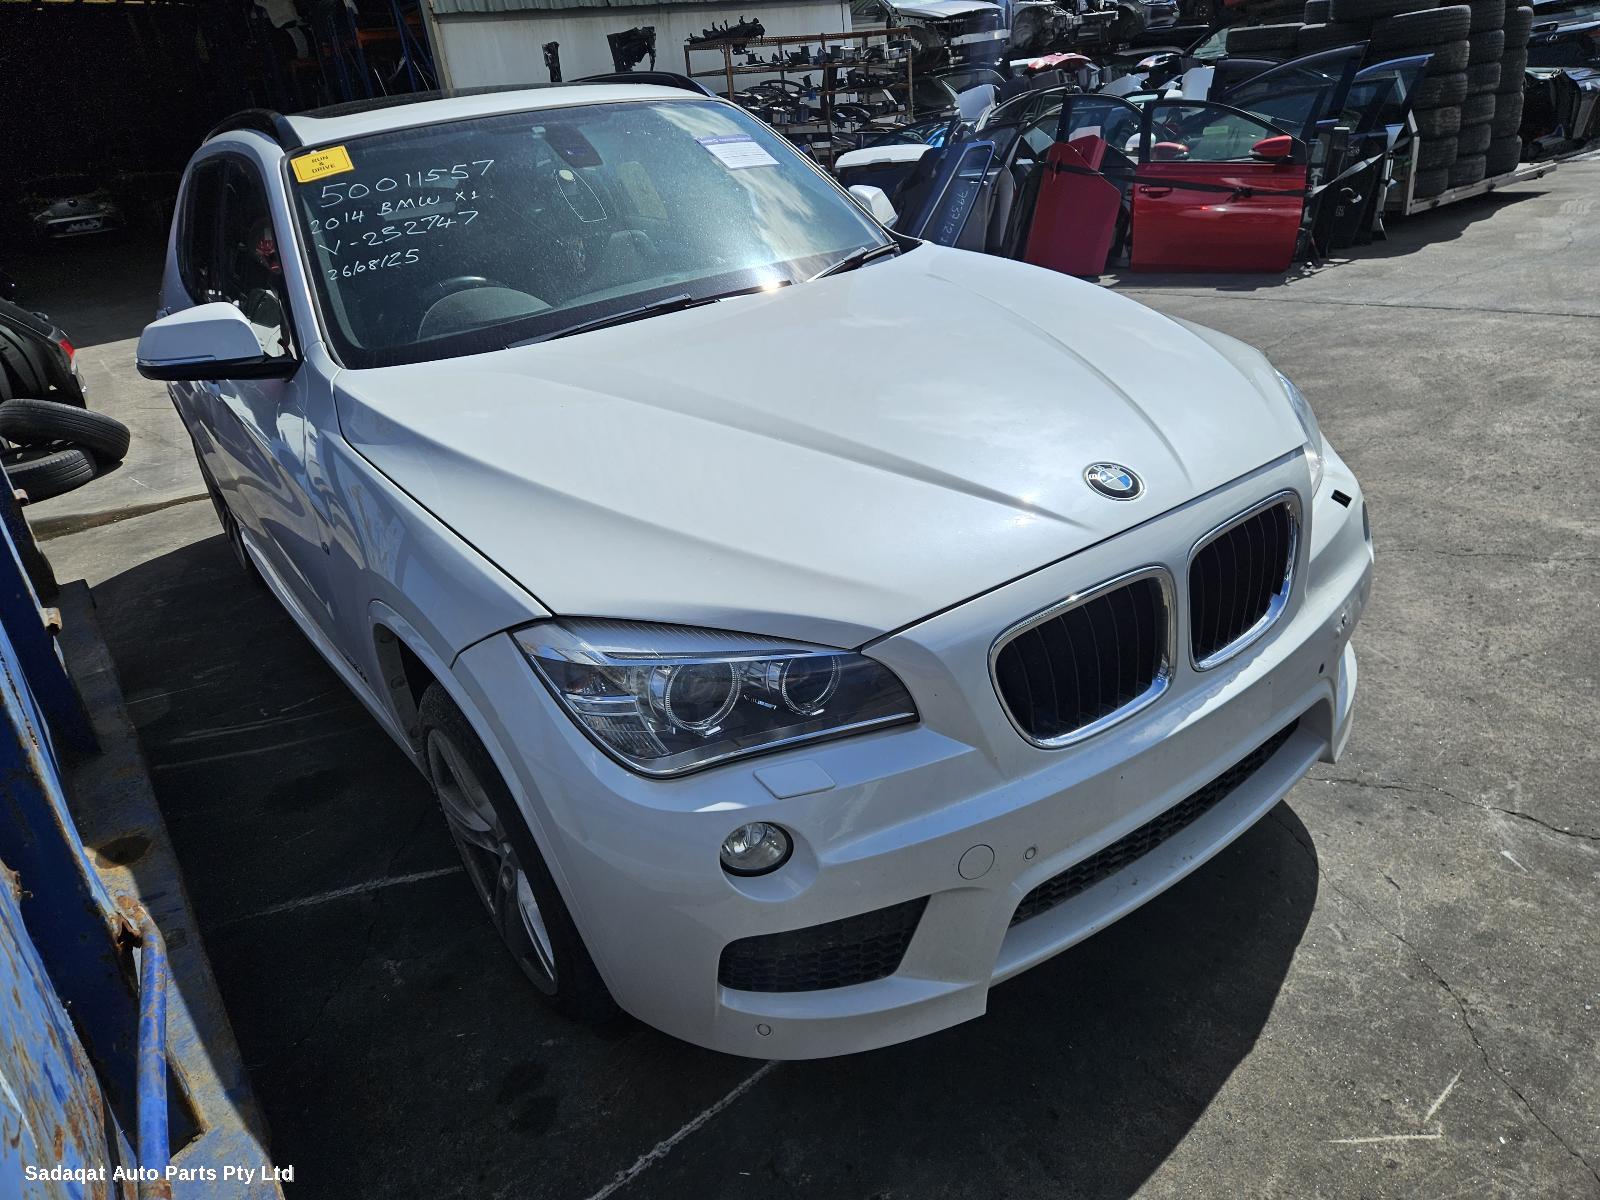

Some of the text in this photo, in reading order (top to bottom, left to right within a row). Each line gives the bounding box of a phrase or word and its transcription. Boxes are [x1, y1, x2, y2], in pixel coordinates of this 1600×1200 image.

[311, 155, 329, 164] RUN
[311, 164, 336, 174] DRIVE
[320, 159, 495, 208] 50011557
[310, 210, 365, 235] 2014
[377, 194, 441, 216] BMW
[327, 248, 420, 281] 26/08/25
